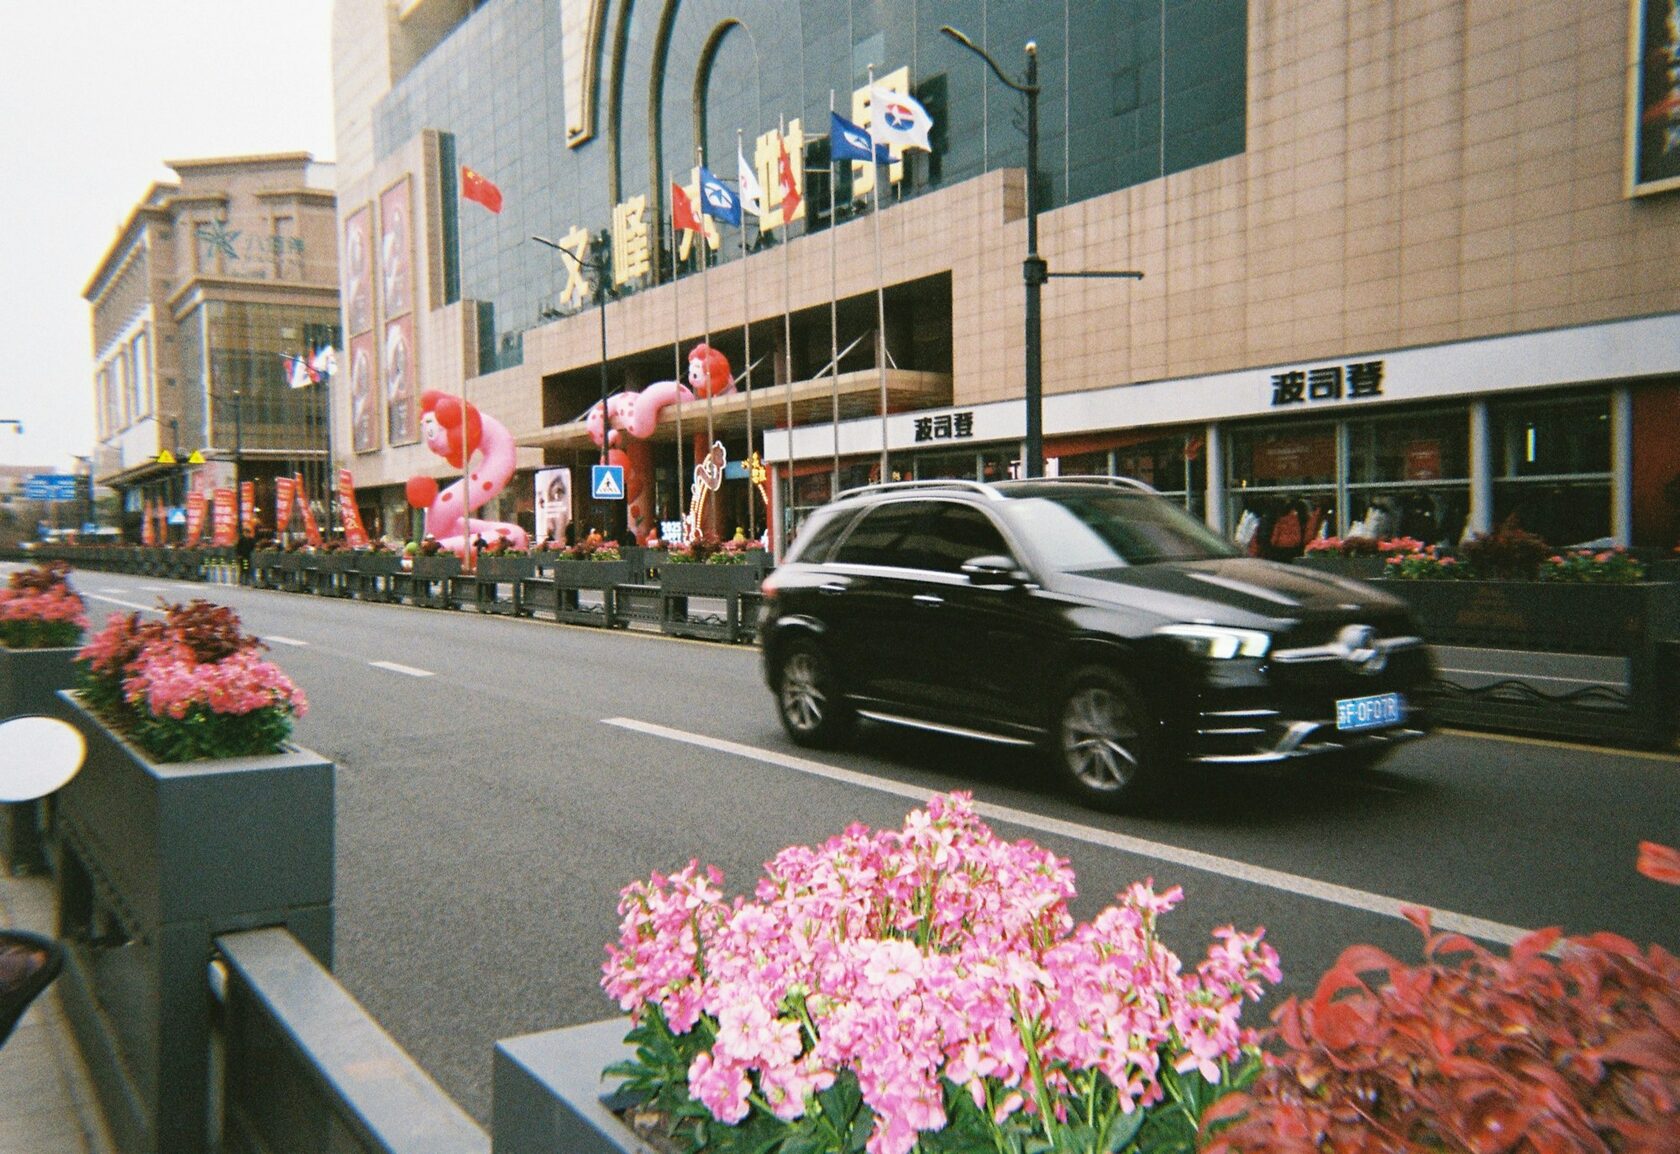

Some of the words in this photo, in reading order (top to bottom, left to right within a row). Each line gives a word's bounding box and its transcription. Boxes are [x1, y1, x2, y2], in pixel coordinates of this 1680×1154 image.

[1271, 360, 1384, 406] 波司登
[914, 411, 974, 442] 波司登
